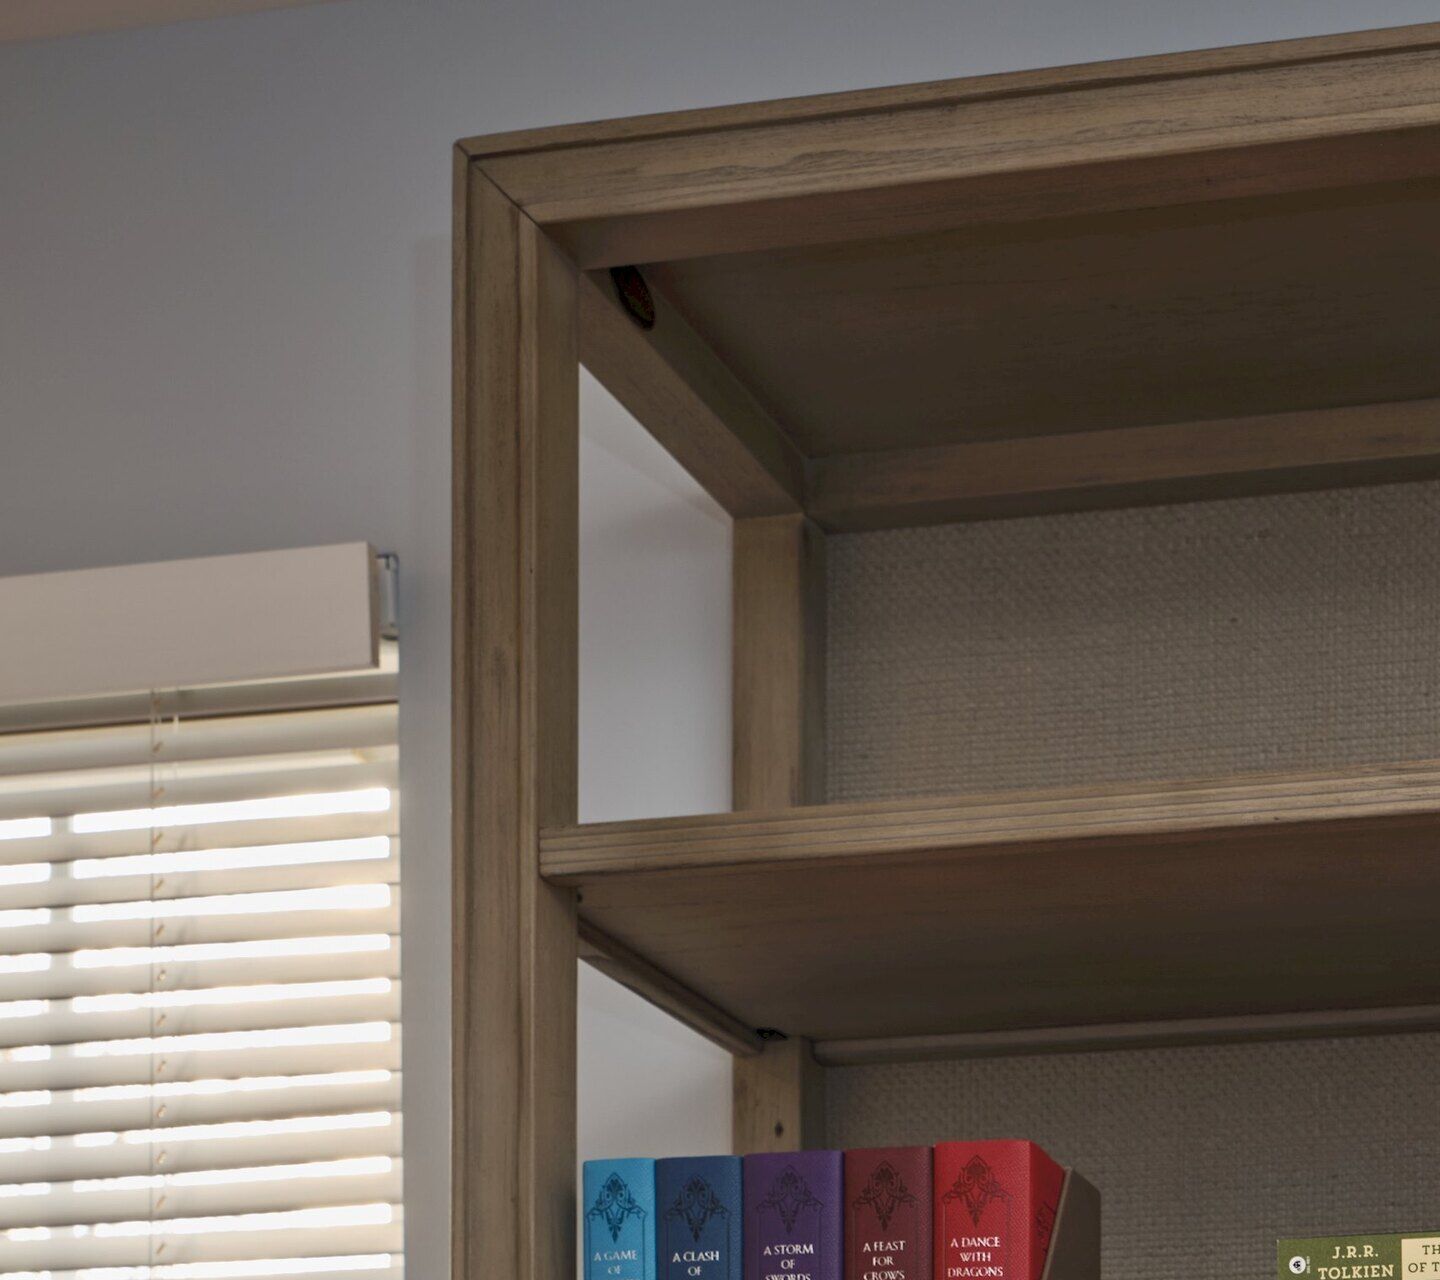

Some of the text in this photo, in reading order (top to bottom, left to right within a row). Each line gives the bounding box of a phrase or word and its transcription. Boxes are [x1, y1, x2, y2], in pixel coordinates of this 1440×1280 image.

[863, 1241, 906, 1252] A FEAST
[951, 1236, 1000, 1248] A DANCE
[960, 1252, 991, 1261] WITH
[1332, 1245, 1378, 1259] J.R.R.
[873, 1256, 894, 1266] FOR
[948, 1267, 1003, 1277] DRAGONS
[1318, 1265, 1394, 1280] TOLKIEN
[1408, 1262, 1427, 1273] OF
